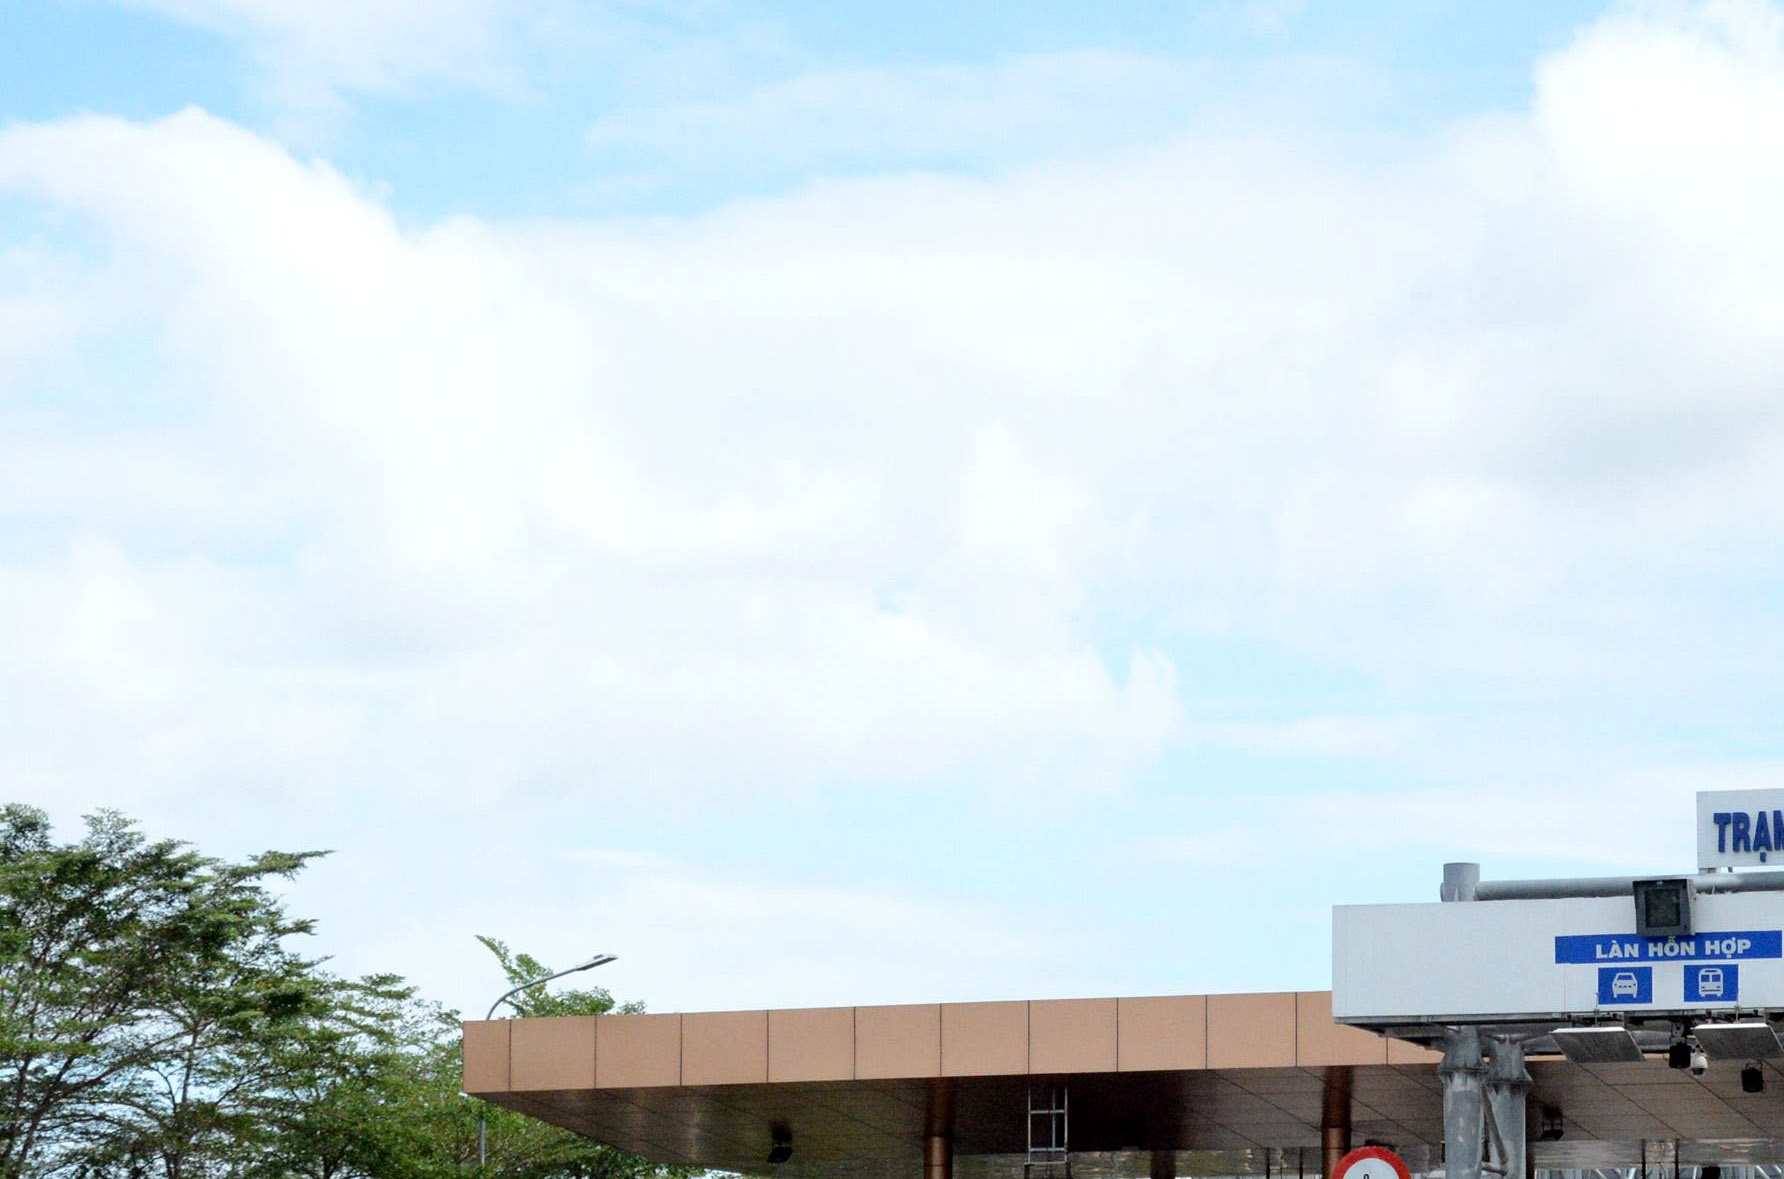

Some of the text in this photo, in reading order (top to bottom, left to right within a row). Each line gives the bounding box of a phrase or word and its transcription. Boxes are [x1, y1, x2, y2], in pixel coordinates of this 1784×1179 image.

[1595, 936, 1752, 959] LÀN HỖN HỢP
